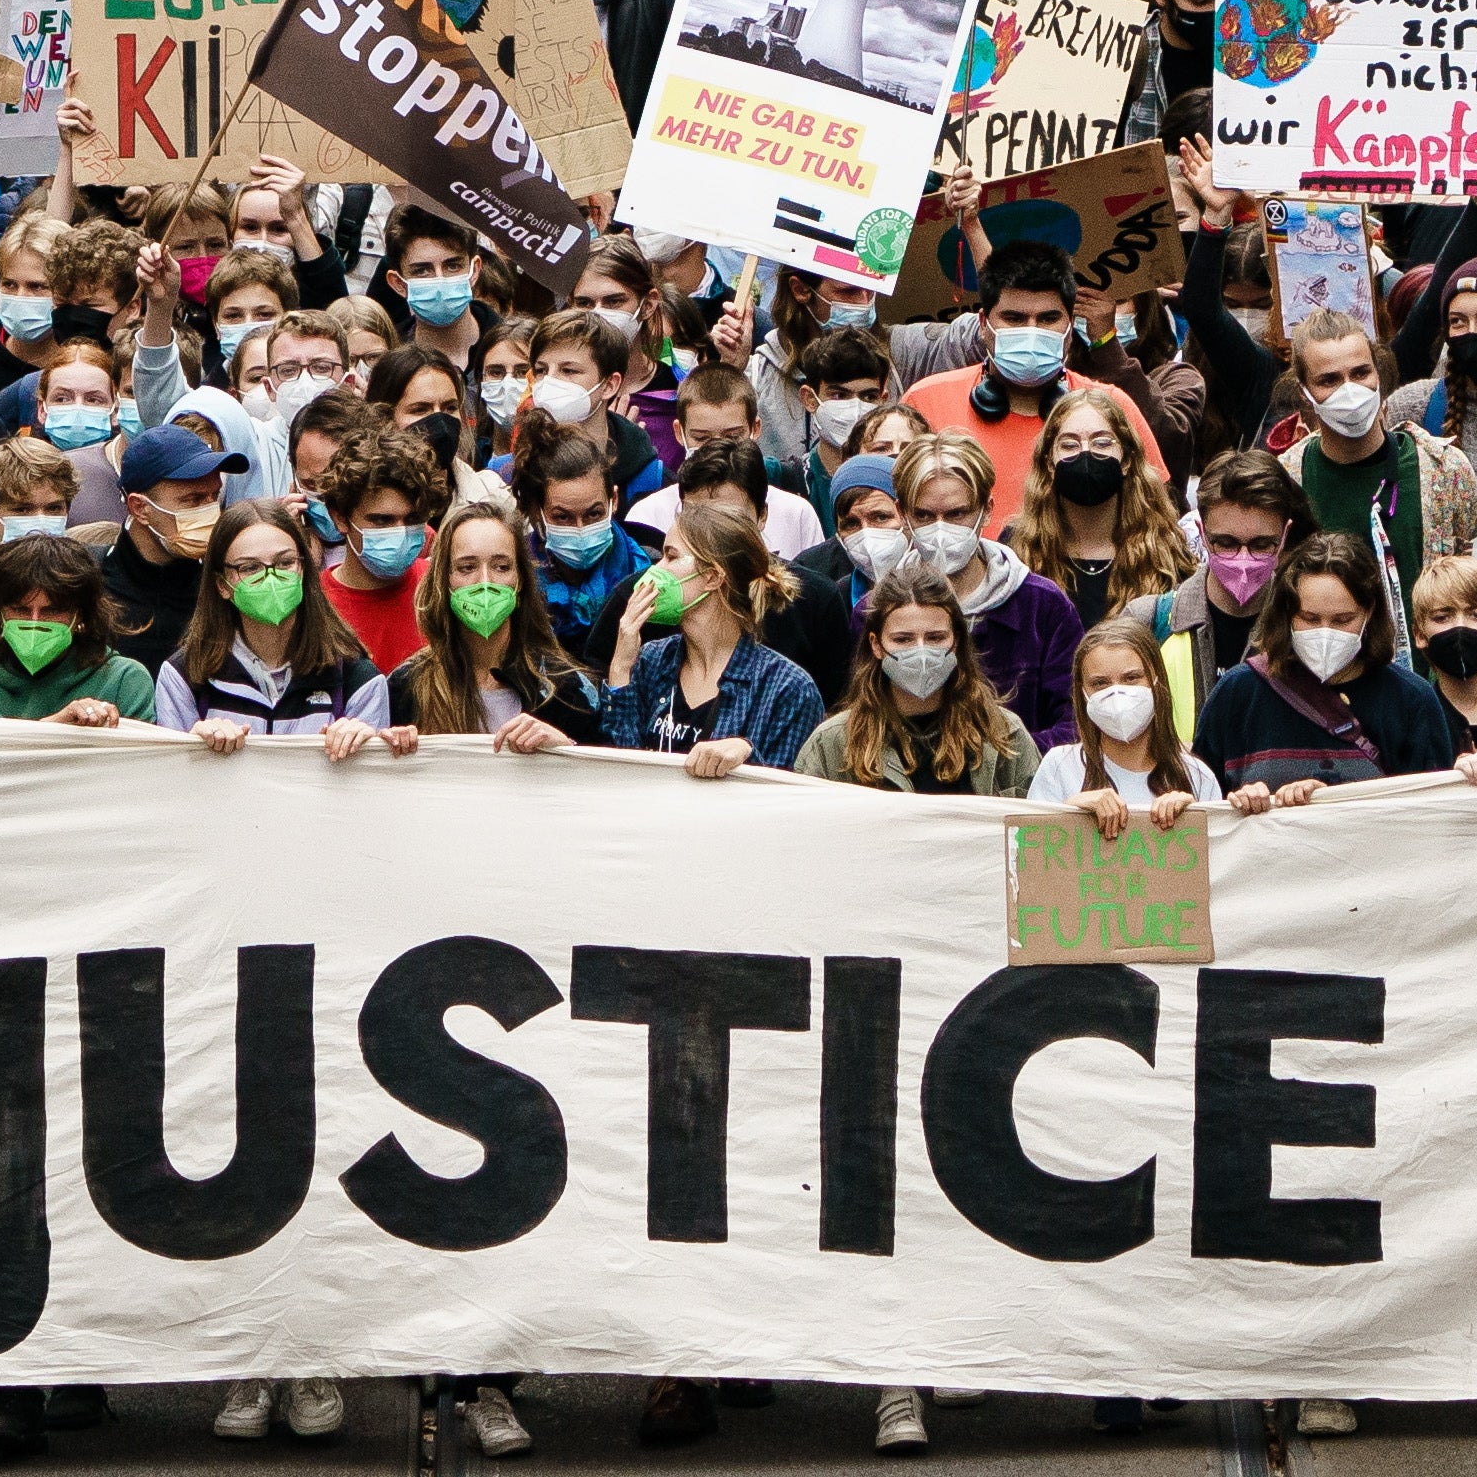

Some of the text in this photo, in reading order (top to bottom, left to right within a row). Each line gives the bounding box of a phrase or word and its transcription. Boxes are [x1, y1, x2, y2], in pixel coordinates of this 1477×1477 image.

[694, 88, 860, 150] NIE GAB ES
[984, 108, 1117, 179] PENNT
[1216, 94, 1301, 146] wir
[657, 116, 867, 192] MEHR ZU TUN.
[449, 180, 584, 264] campact!
[523, 212, 562, 240] Politik
[1016, 824, 1199, 872] FRIDAYS
[1078, 872, 1148, 900] FOR
[1016, 901, 1199, 953] FUTURE
